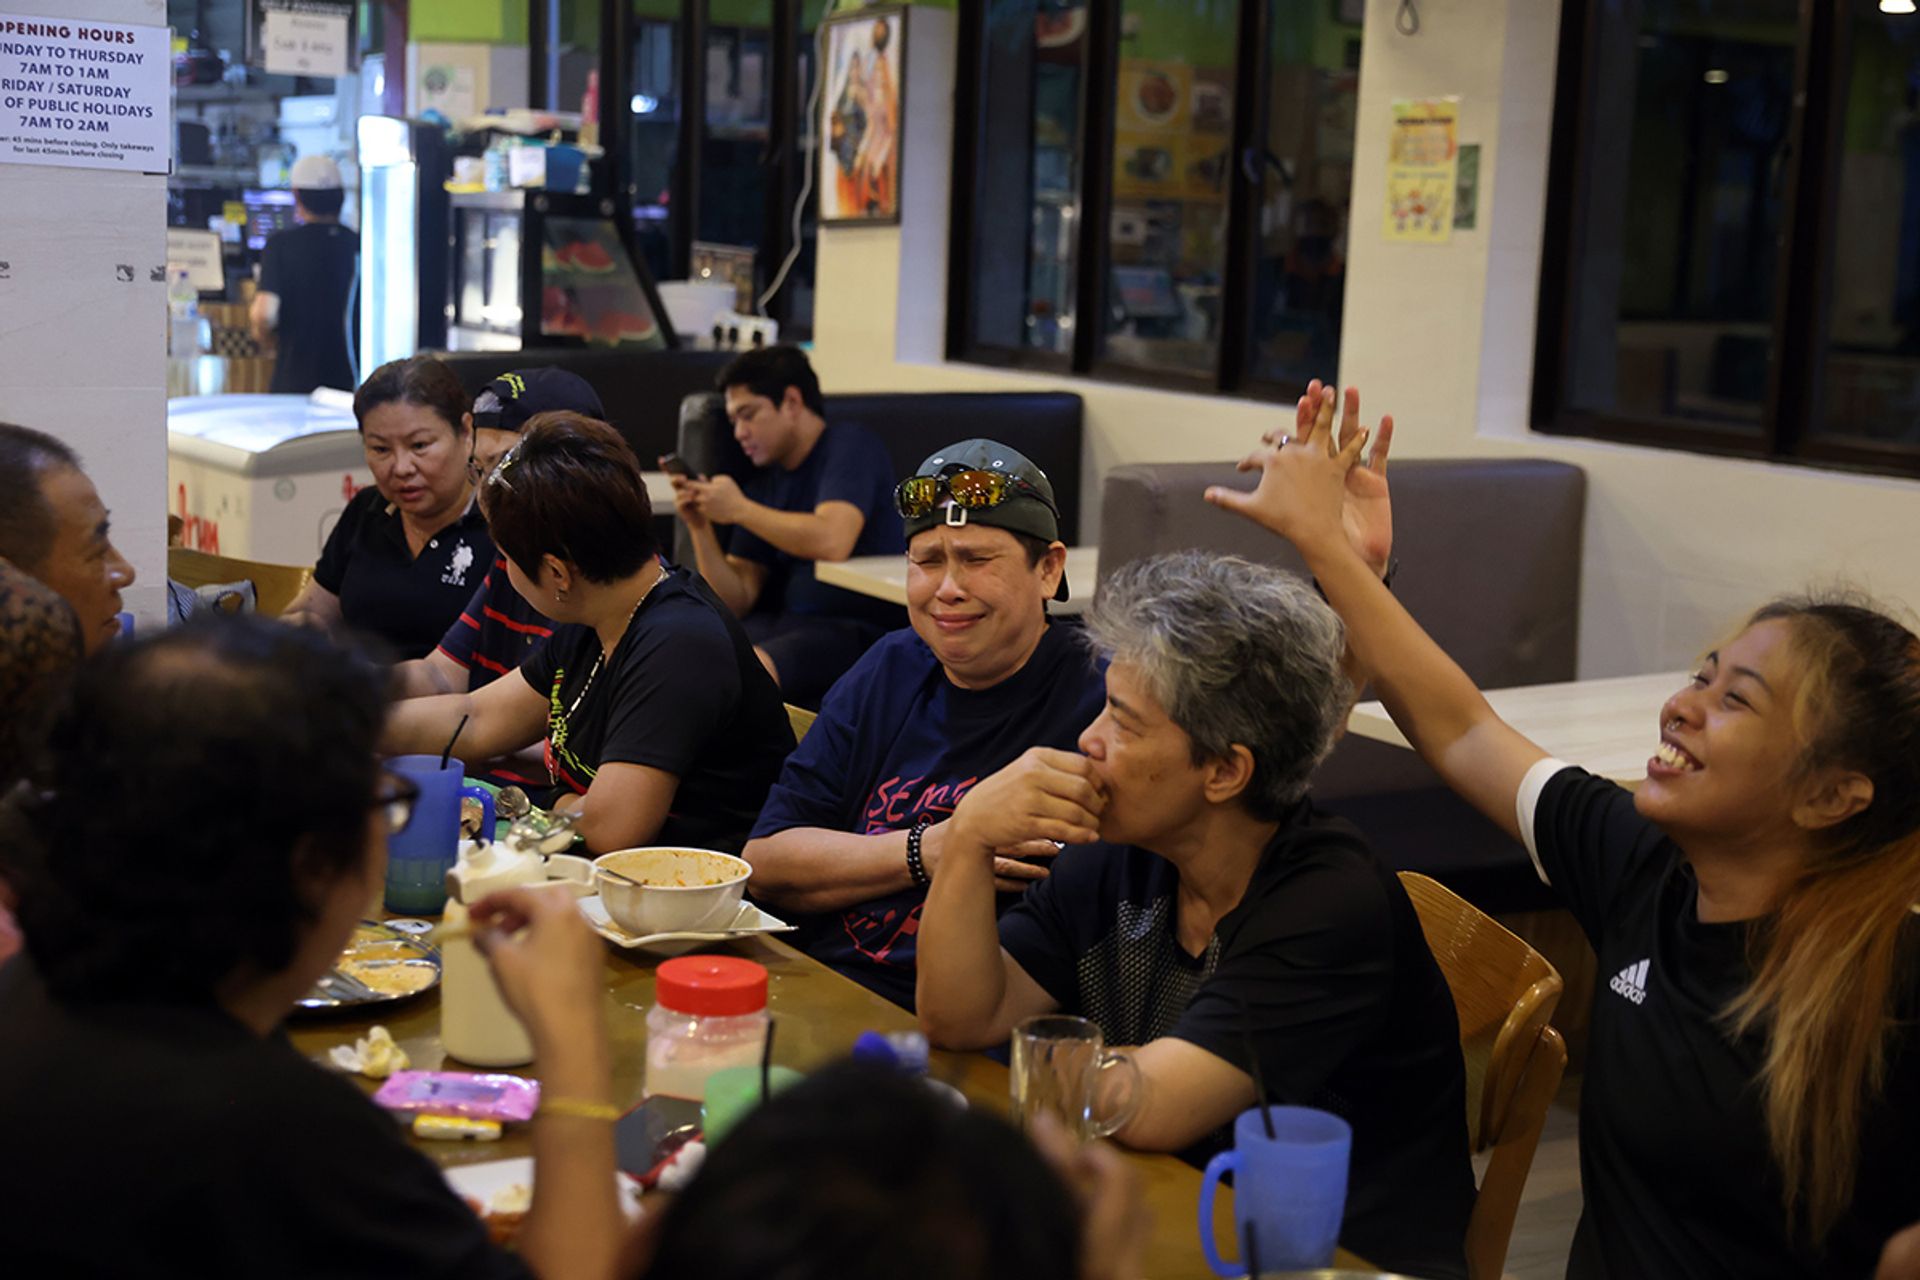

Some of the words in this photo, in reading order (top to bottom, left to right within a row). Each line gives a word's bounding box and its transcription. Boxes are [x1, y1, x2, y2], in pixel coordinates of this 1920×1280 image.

[78, 28, 135, 44] HOURS
[0, 42, 43, 57] NDAY
[46, 45, 65, 60] TO
[69, 48, 144, 65] THURSDAY
[20, 62, 51, 75] 7AM
[55, 64, 74, 77] TO
[79, 67, 109, 80] 1AM
[48, 82, 54, 93] /
[58, 83, 131, 99] SATURDAY
[5, 96, 24, 109] OF
[29, 98, 79, 113] PUBLIC
[84, 102, 153, 118] HOLIDAYS
[20, 116, 51, 129] 7AM
[55, 118, 74, 130] TO
[78, 120, 109, 133] 2AM
[13, 136, 22, 144] 45
[44, 138, 69, 146] before
[100, 141, 118, 150] Only
[13, 145, 24, 153] for
[26, 146, 40, 154] last
[42, 147, 70, 156] 45mins
[71, 149, 96, 158] before
[97, 151, 124, 160] closing
[1609, 975, 1646, 1005] adidas
